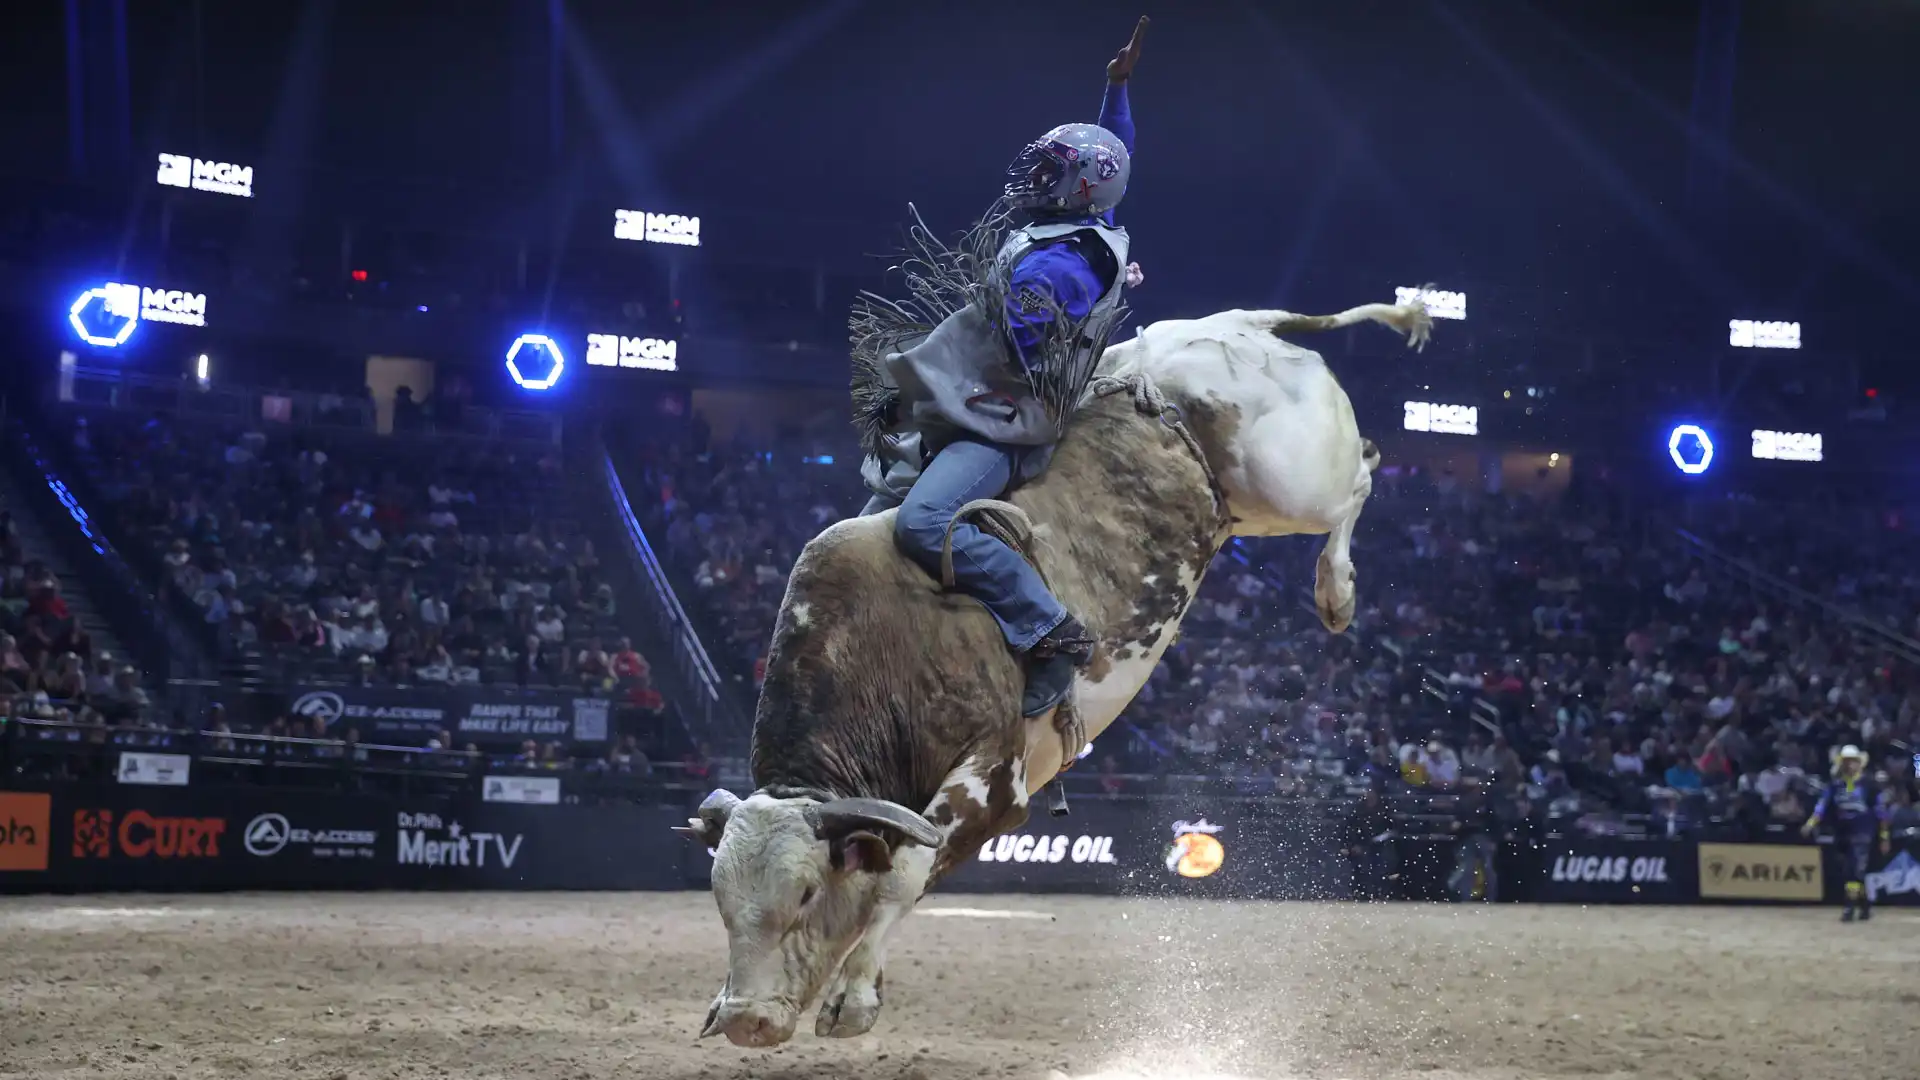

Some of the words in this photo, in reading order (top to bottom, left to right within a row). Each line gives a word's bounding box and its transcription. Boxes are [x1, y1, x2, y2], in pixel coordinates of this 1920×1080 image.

[193, 159, 252, 185] MGM
[646, 212, 699, 235] MGM
[142, 287, 206, 314] MGM
[1753, 320, 1800, 339] MGM
[620, 336, 676, 360] MGM
[1430, 403, 1477, 425] MGM
[1775, 431, 1822, 451] MGM
[470, 704, 521, 718] RAMPS
[525, 705, 561, 718] THAT
[458, 718, 499, 731] MAKE
[501, 719, 530, 733] LIFE
[532, 720, 571, 733] EASY
[118, 809, 225, 858] CURT
[977, 834, 1067, 863] LUCAS
[1071, 835, 1113, 863] OIL
[1552, 856, 1627, 881] LUCAS
[1630, 857, 1667, 881] OIL
[1731, 864, 1817, 886] ARIAT
